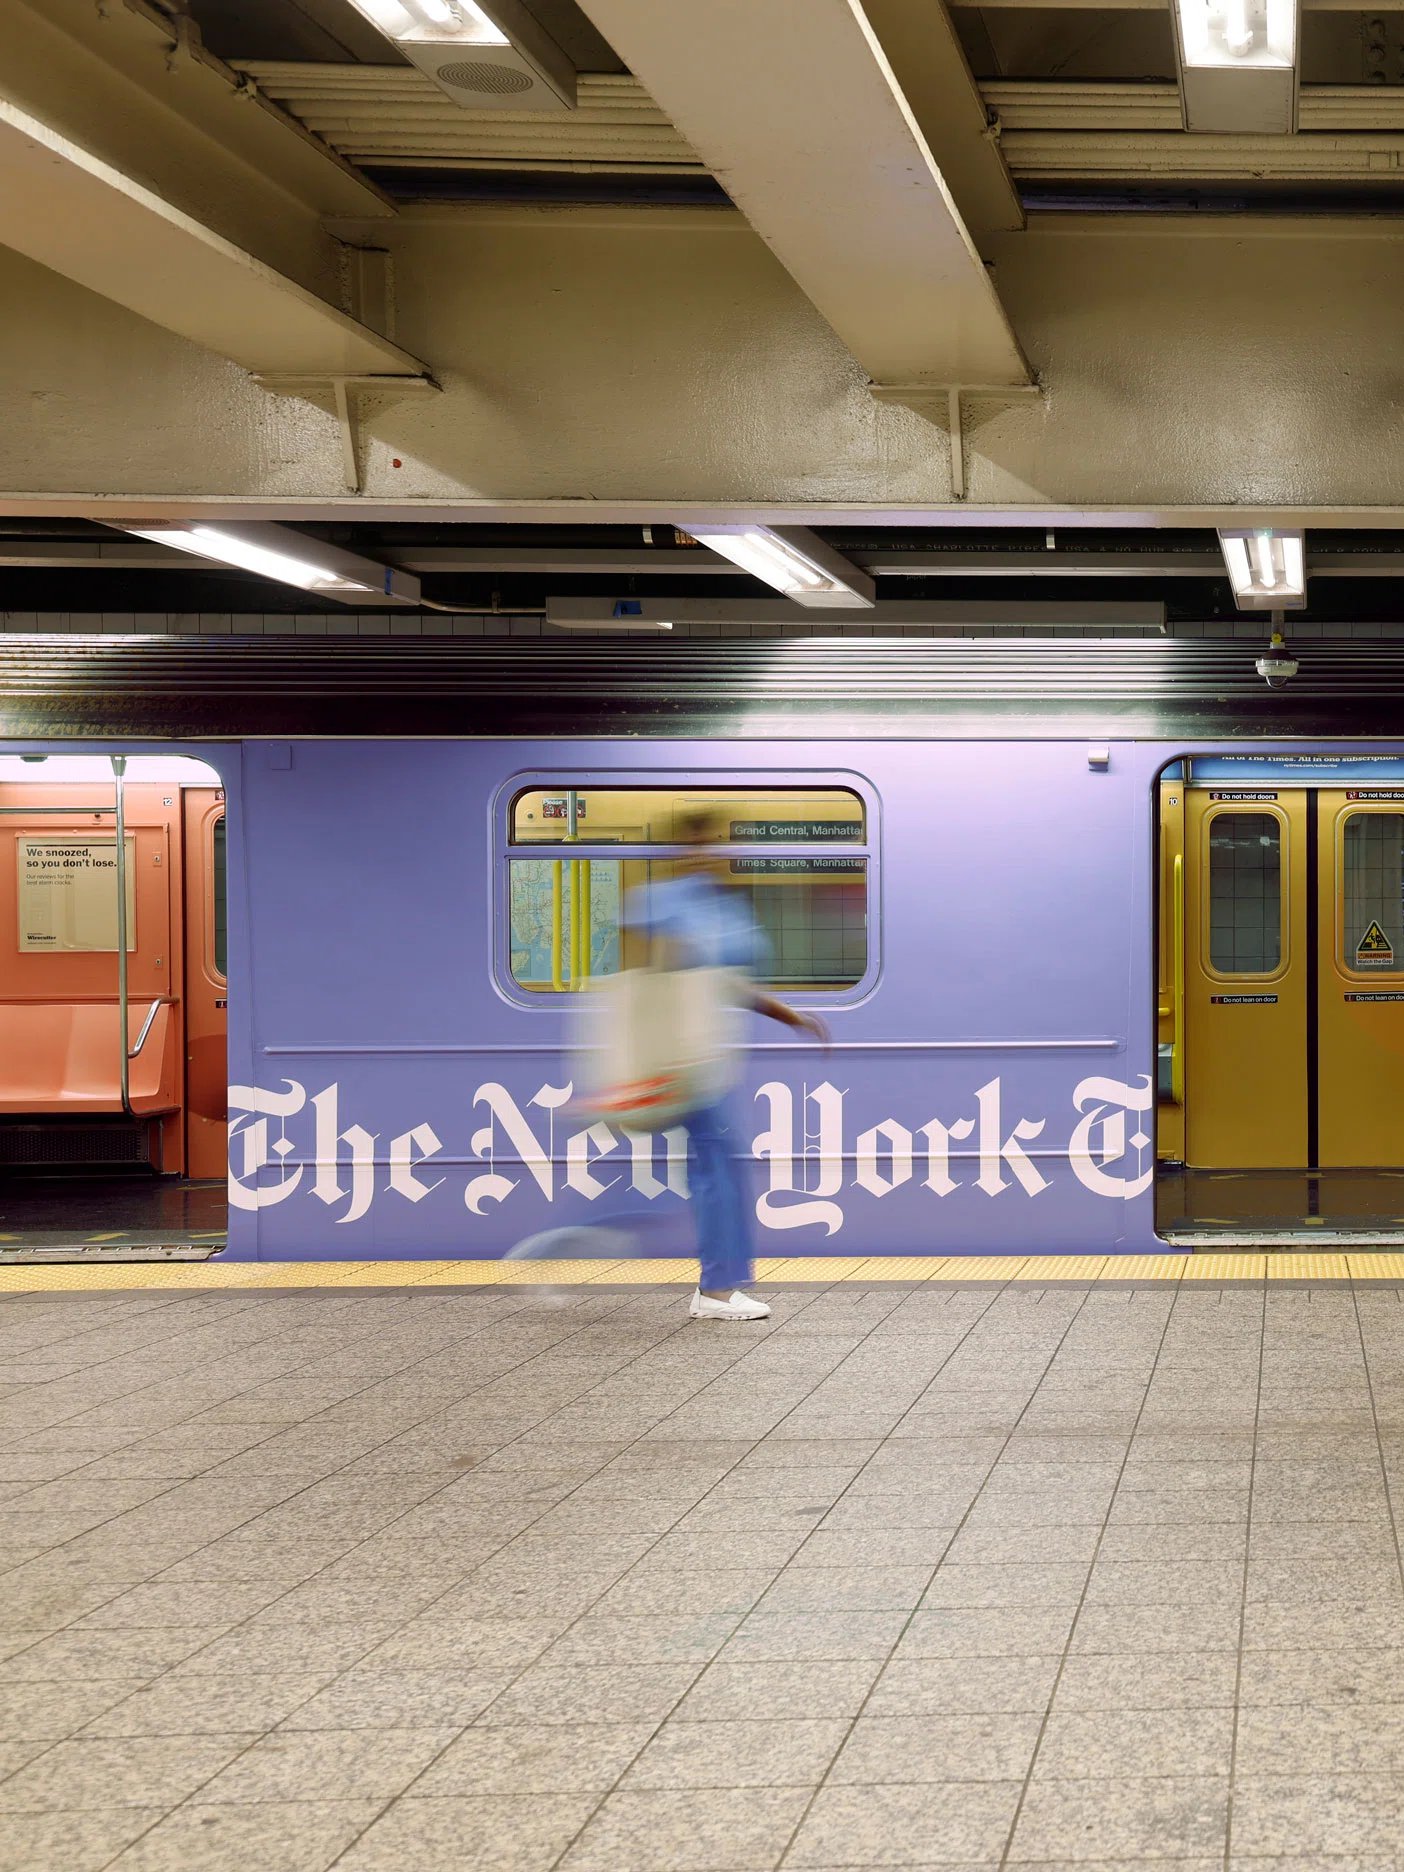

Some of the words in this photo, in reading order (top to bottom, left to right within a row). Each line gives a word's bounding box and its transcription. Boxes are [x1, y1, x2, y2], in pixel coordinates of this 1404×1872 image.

[734, 825, 766, 835] Grand
[769, 825, 809, 837] Central,
[26, 848, 43, 856] We
[46, 848, 92, 858] snoozed,
[41, 860, 60, 869] you
[92, 859, 117, 867] lose.
[228, 1079, 447, 1224] The
[752, 1075, 1054, 1237] York
